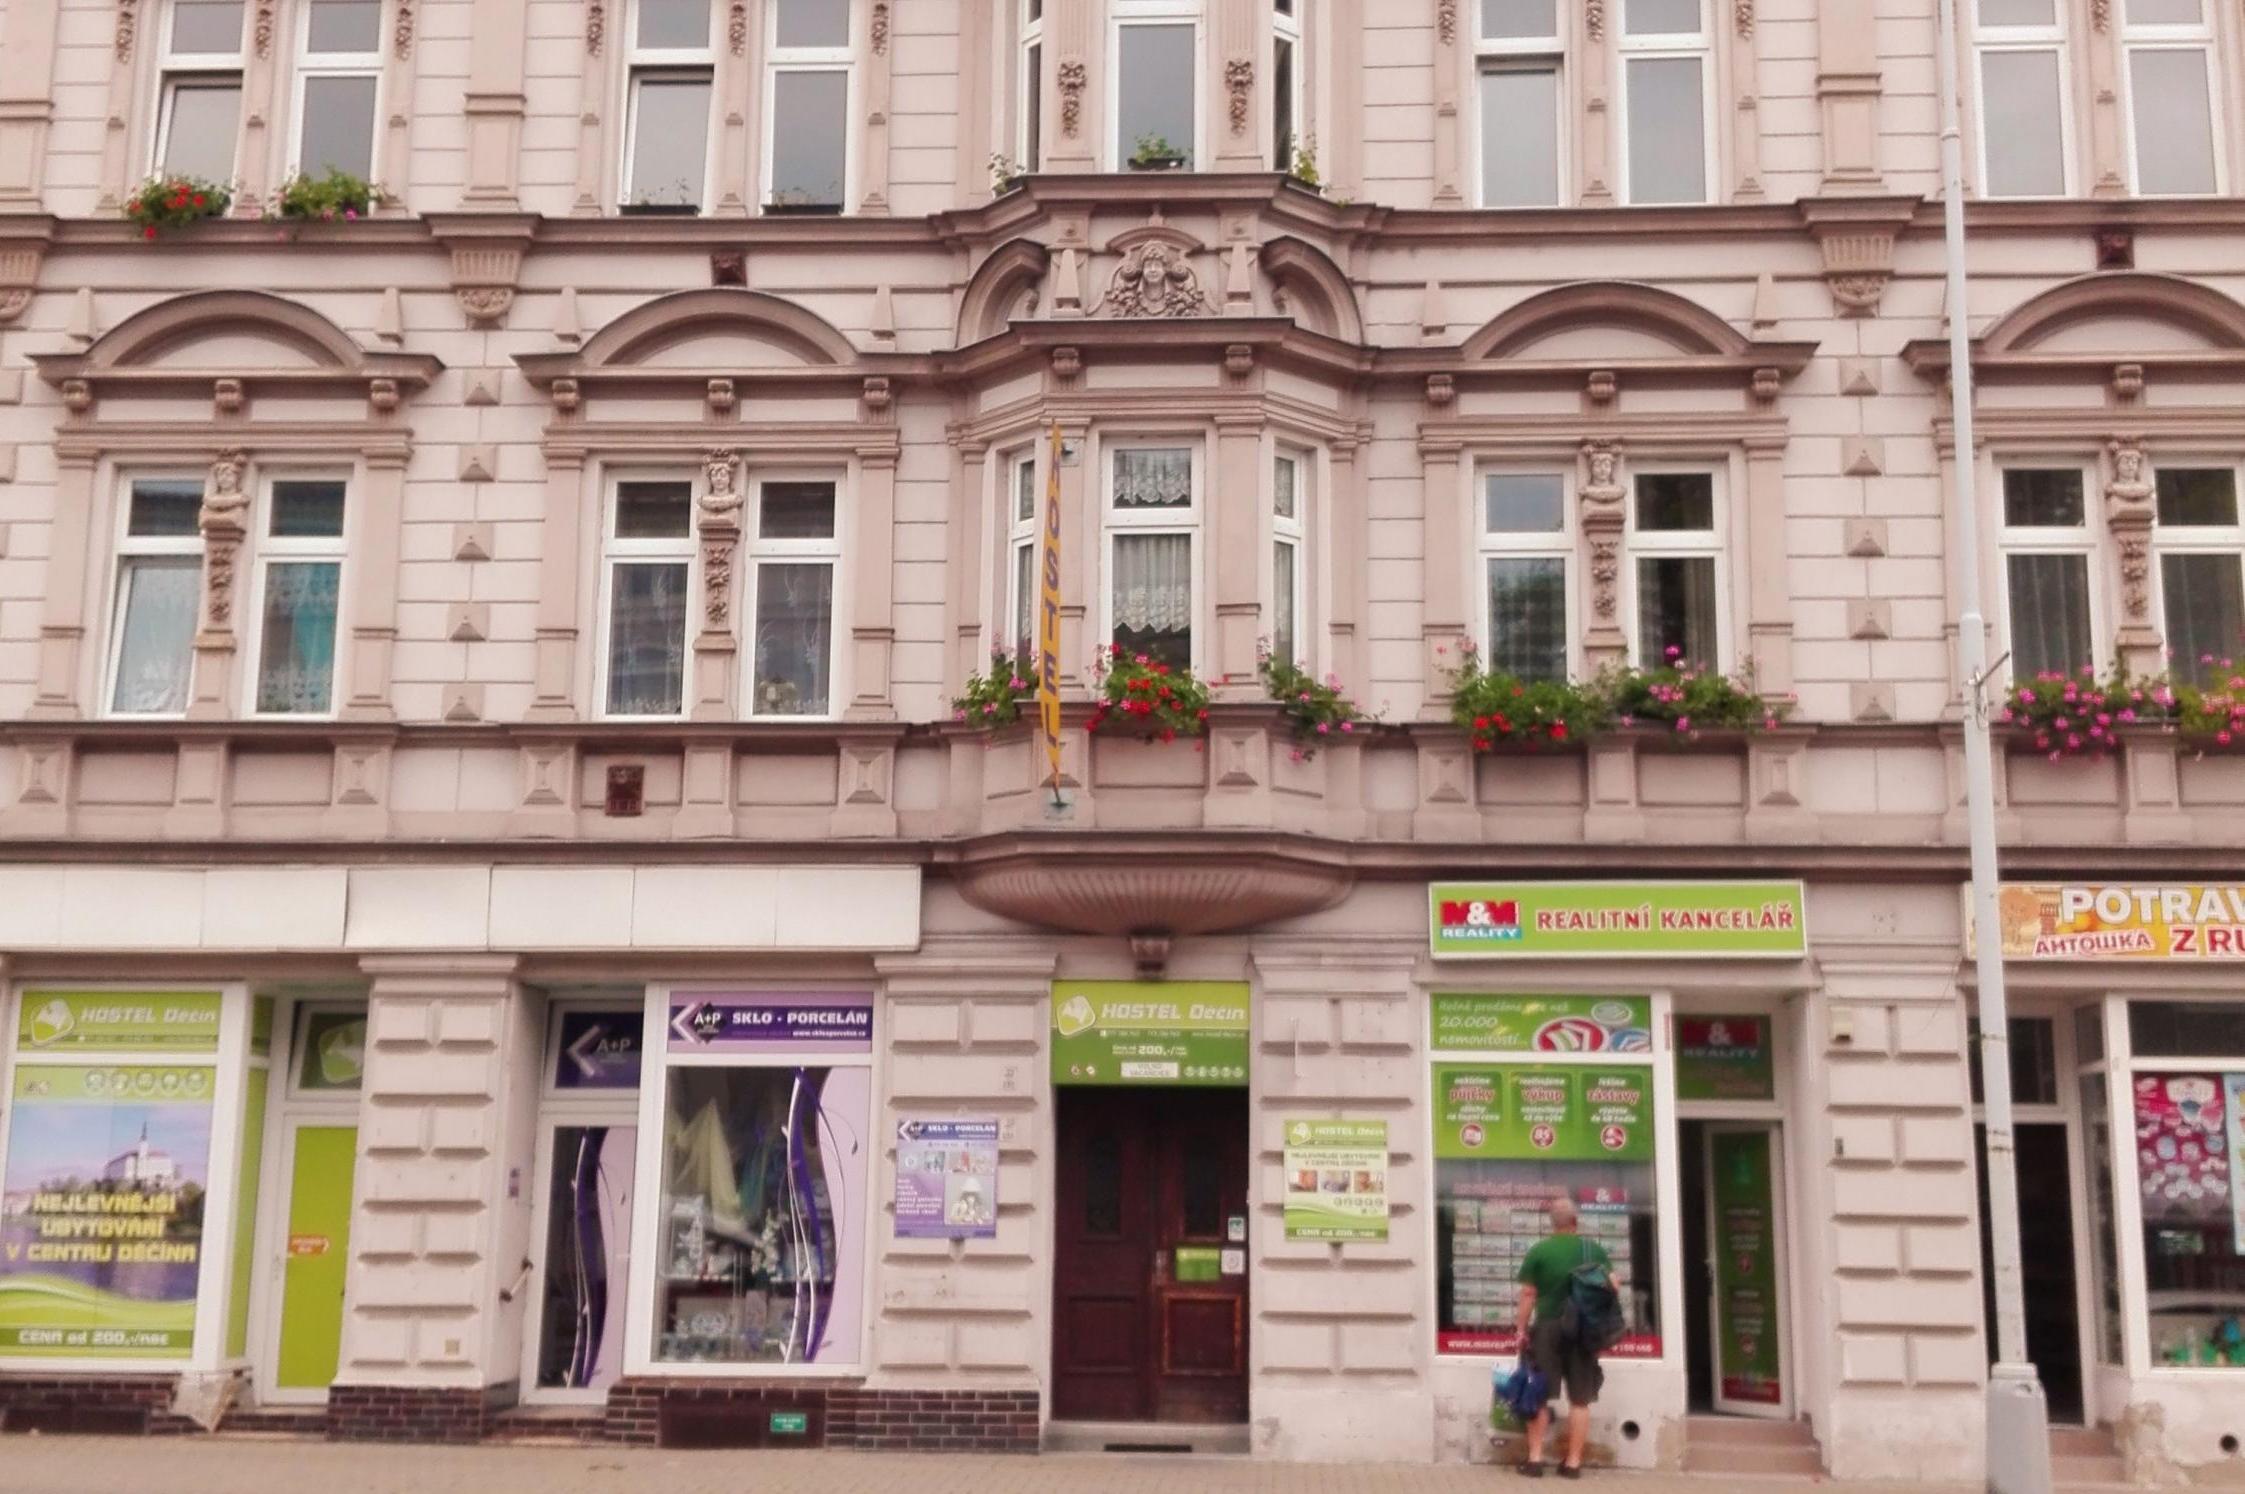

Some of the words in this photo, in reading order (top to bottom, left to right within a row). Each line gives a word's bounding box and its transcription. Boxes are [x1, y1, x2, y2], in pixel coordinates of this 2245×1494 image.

[1044, 441, 1060, 748] HOSTEL
[1536, 904, 1652, 931] REALITNÍ
[1660, 903, 1795, 930] KANCELÁŘ
[1442, 928, 1518, 938] REALITY
[2172, 929, 2196, 952] Z
[80, 1007, 155, 1023] HOSTEL
[694, 1013, 722, 1025] A+P
[732, 1011, 772, 1024] SKLO
[787, 1009, 868, 1024] PORCELÁN
[1101, 1003, 1181, 1019] HOSTEL
[1439, 1016, 1498, 1028] 20.000
[597, 1037, 632, 1055] A+P
[1315, 1127, 1355, 1136] HOSTEL
[27, 1243, 113, 1263] CENTRU
[66, 1331, 88, 1344] od
